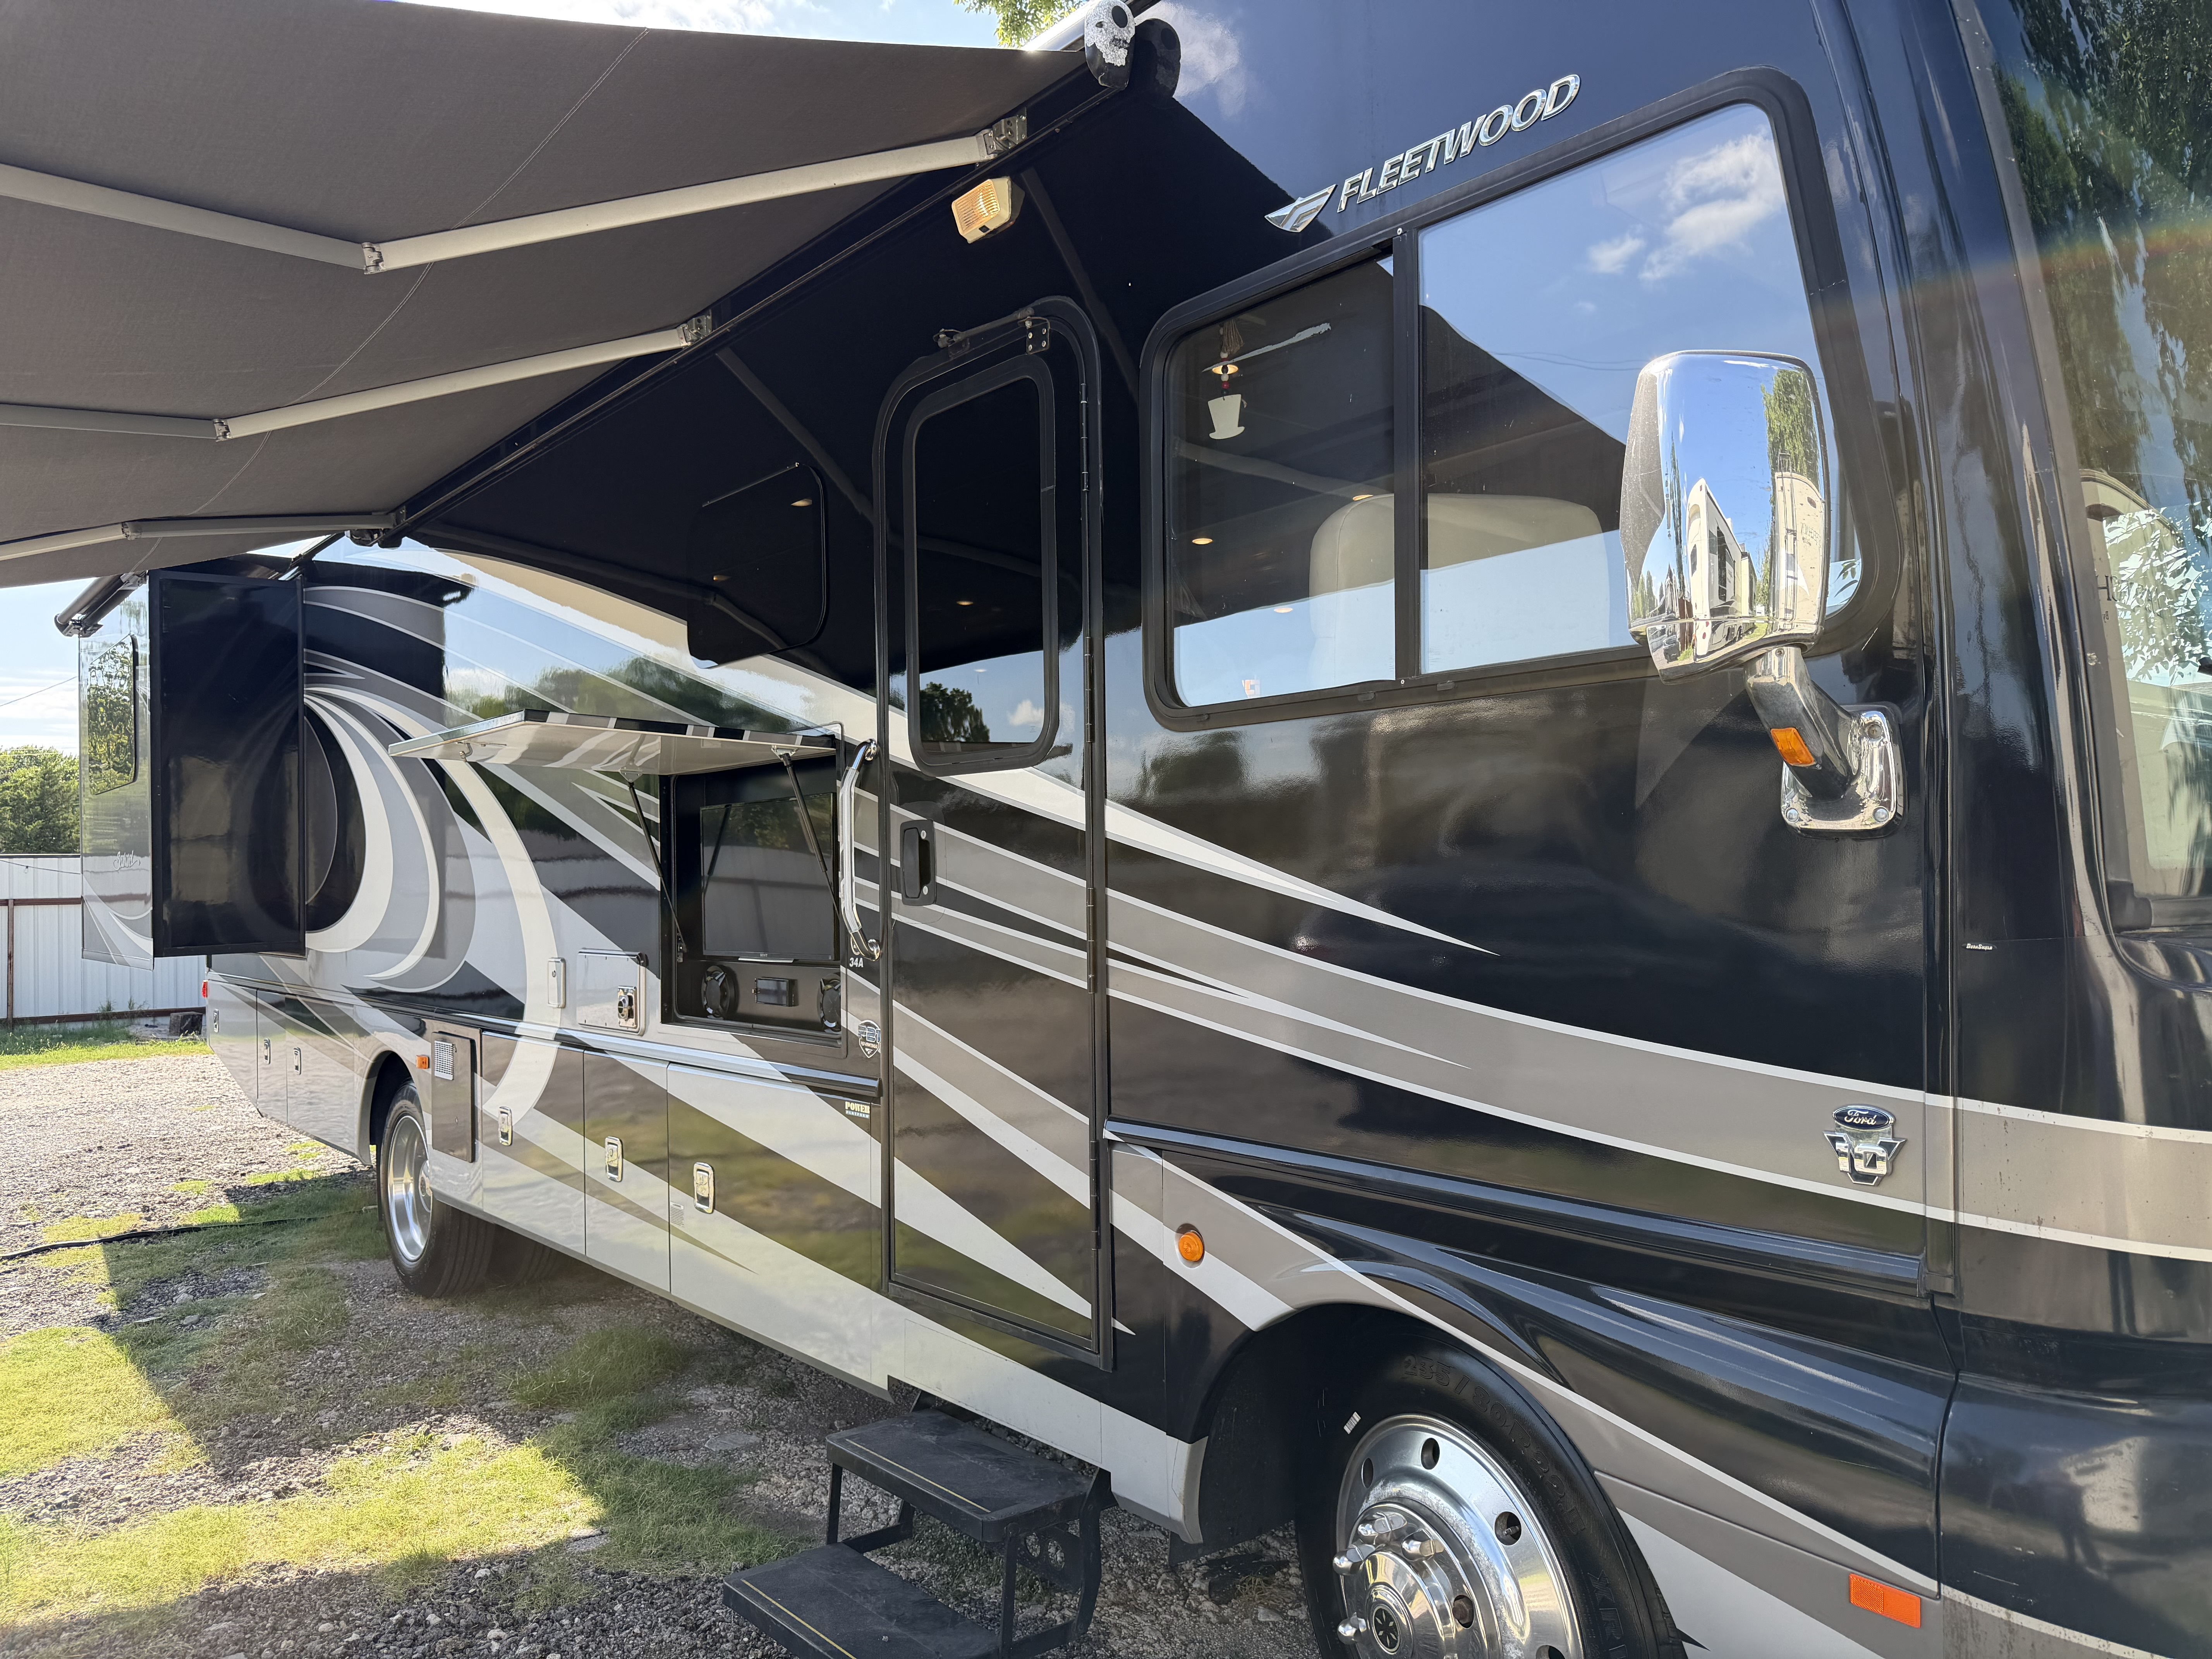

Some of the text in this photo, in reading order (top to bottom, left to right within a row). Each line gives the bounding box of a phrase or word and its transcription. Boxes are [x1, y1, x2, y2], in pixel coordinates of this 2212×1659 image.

[1337, 74, 1581, 213] FLEETWOOD
[849, 957, 864, 967] 34A
[845, 1101, 870, 1114] POWER
[1844, 1109, 1877, 1125] Ford
